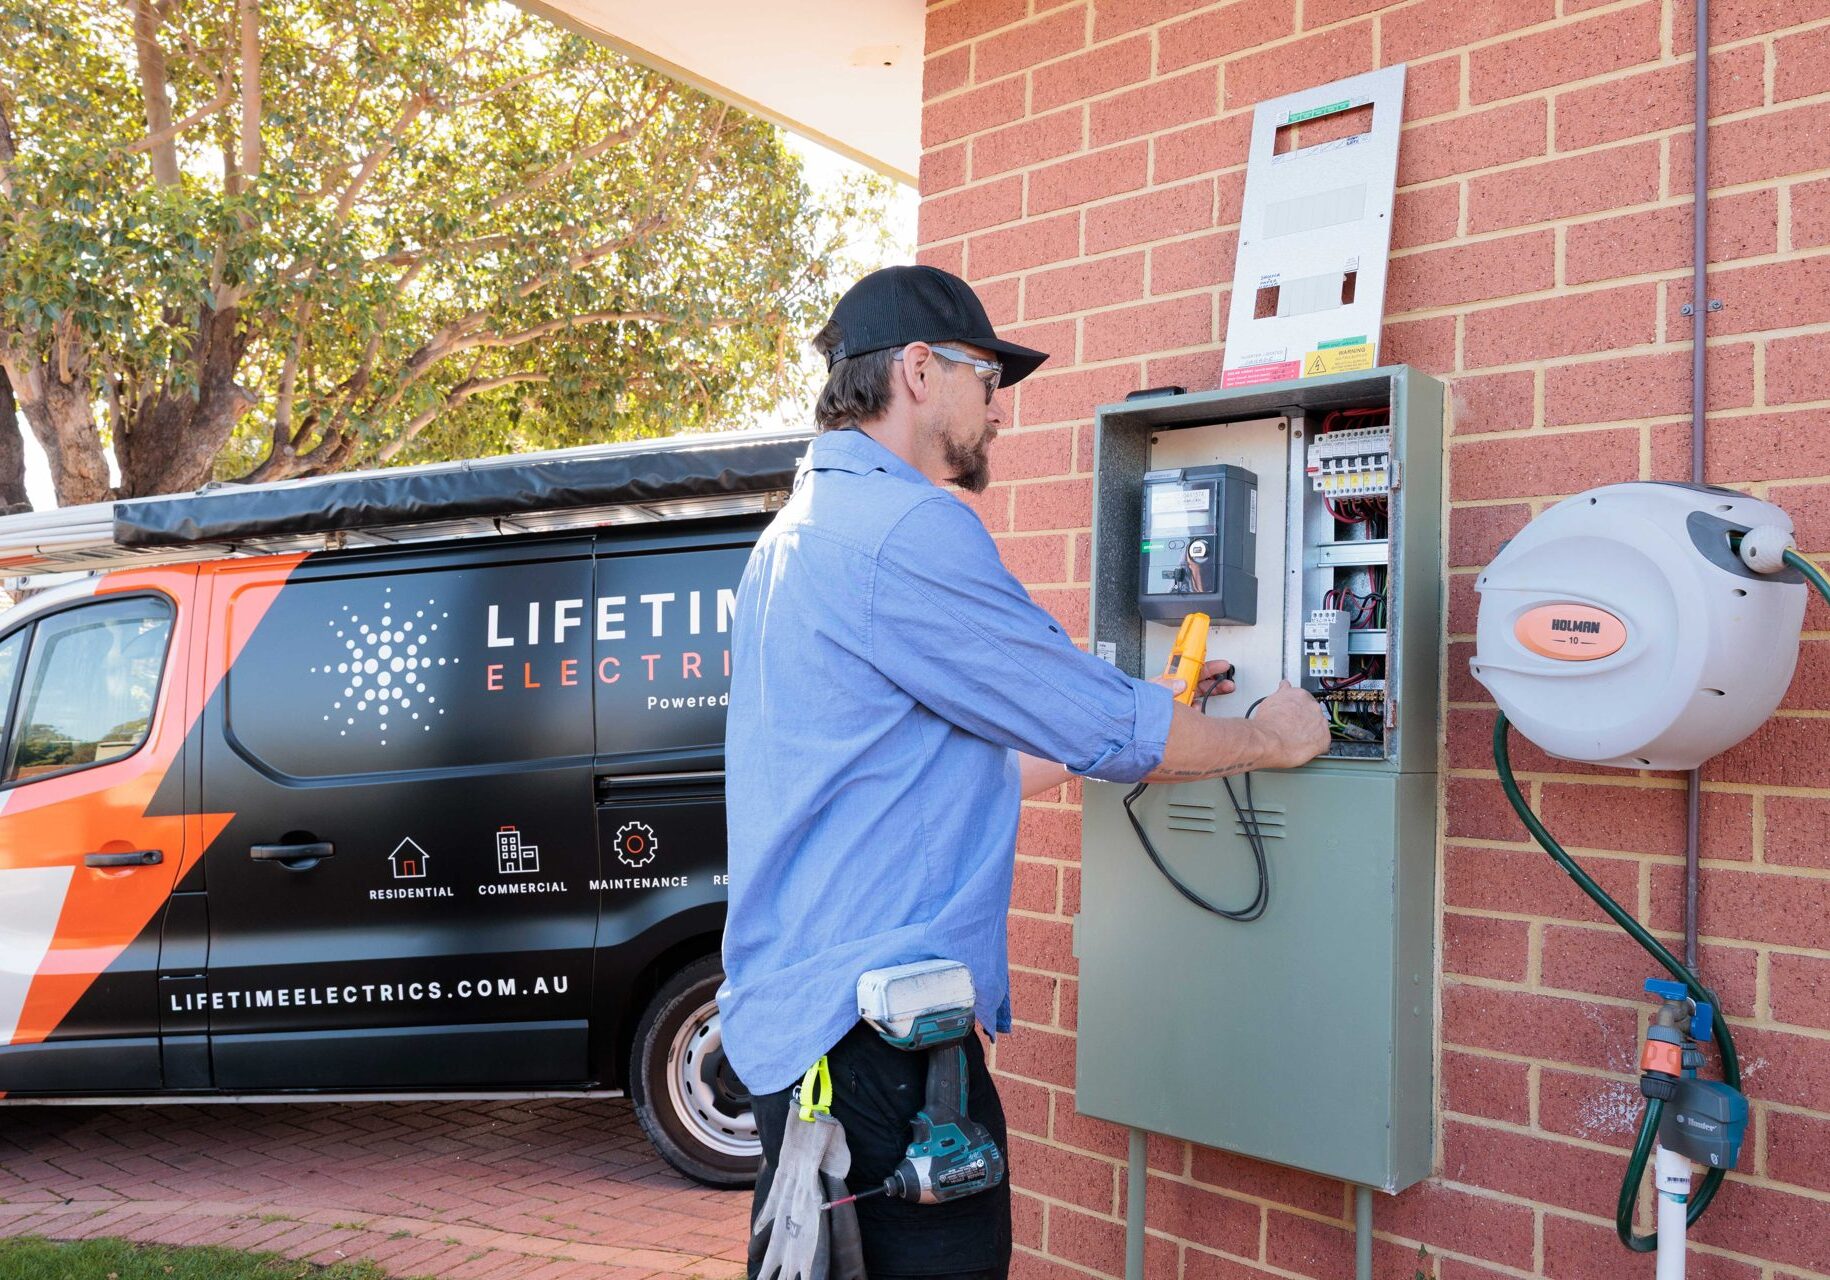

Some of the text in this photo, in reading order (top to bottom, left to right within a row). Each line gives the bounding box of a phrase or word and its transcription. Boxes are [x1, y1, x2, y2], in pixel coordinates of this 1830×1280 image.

[1551, 619, 1600, 634] HOLMAN
[1568, 637, 1579, 645] 10
[487, 649, 730, 691] ELECTRI
[647, 692, 729, 710] Powered
[478, 881, 568, 895] COMMERCIAL
[589, 876, 688, 890] MAINTENANCE
[369, 886, 455, 900] RESIDENTIAL
[170, 975, 569, 1011] LIFETIMEELECTRICS.COM.AU
